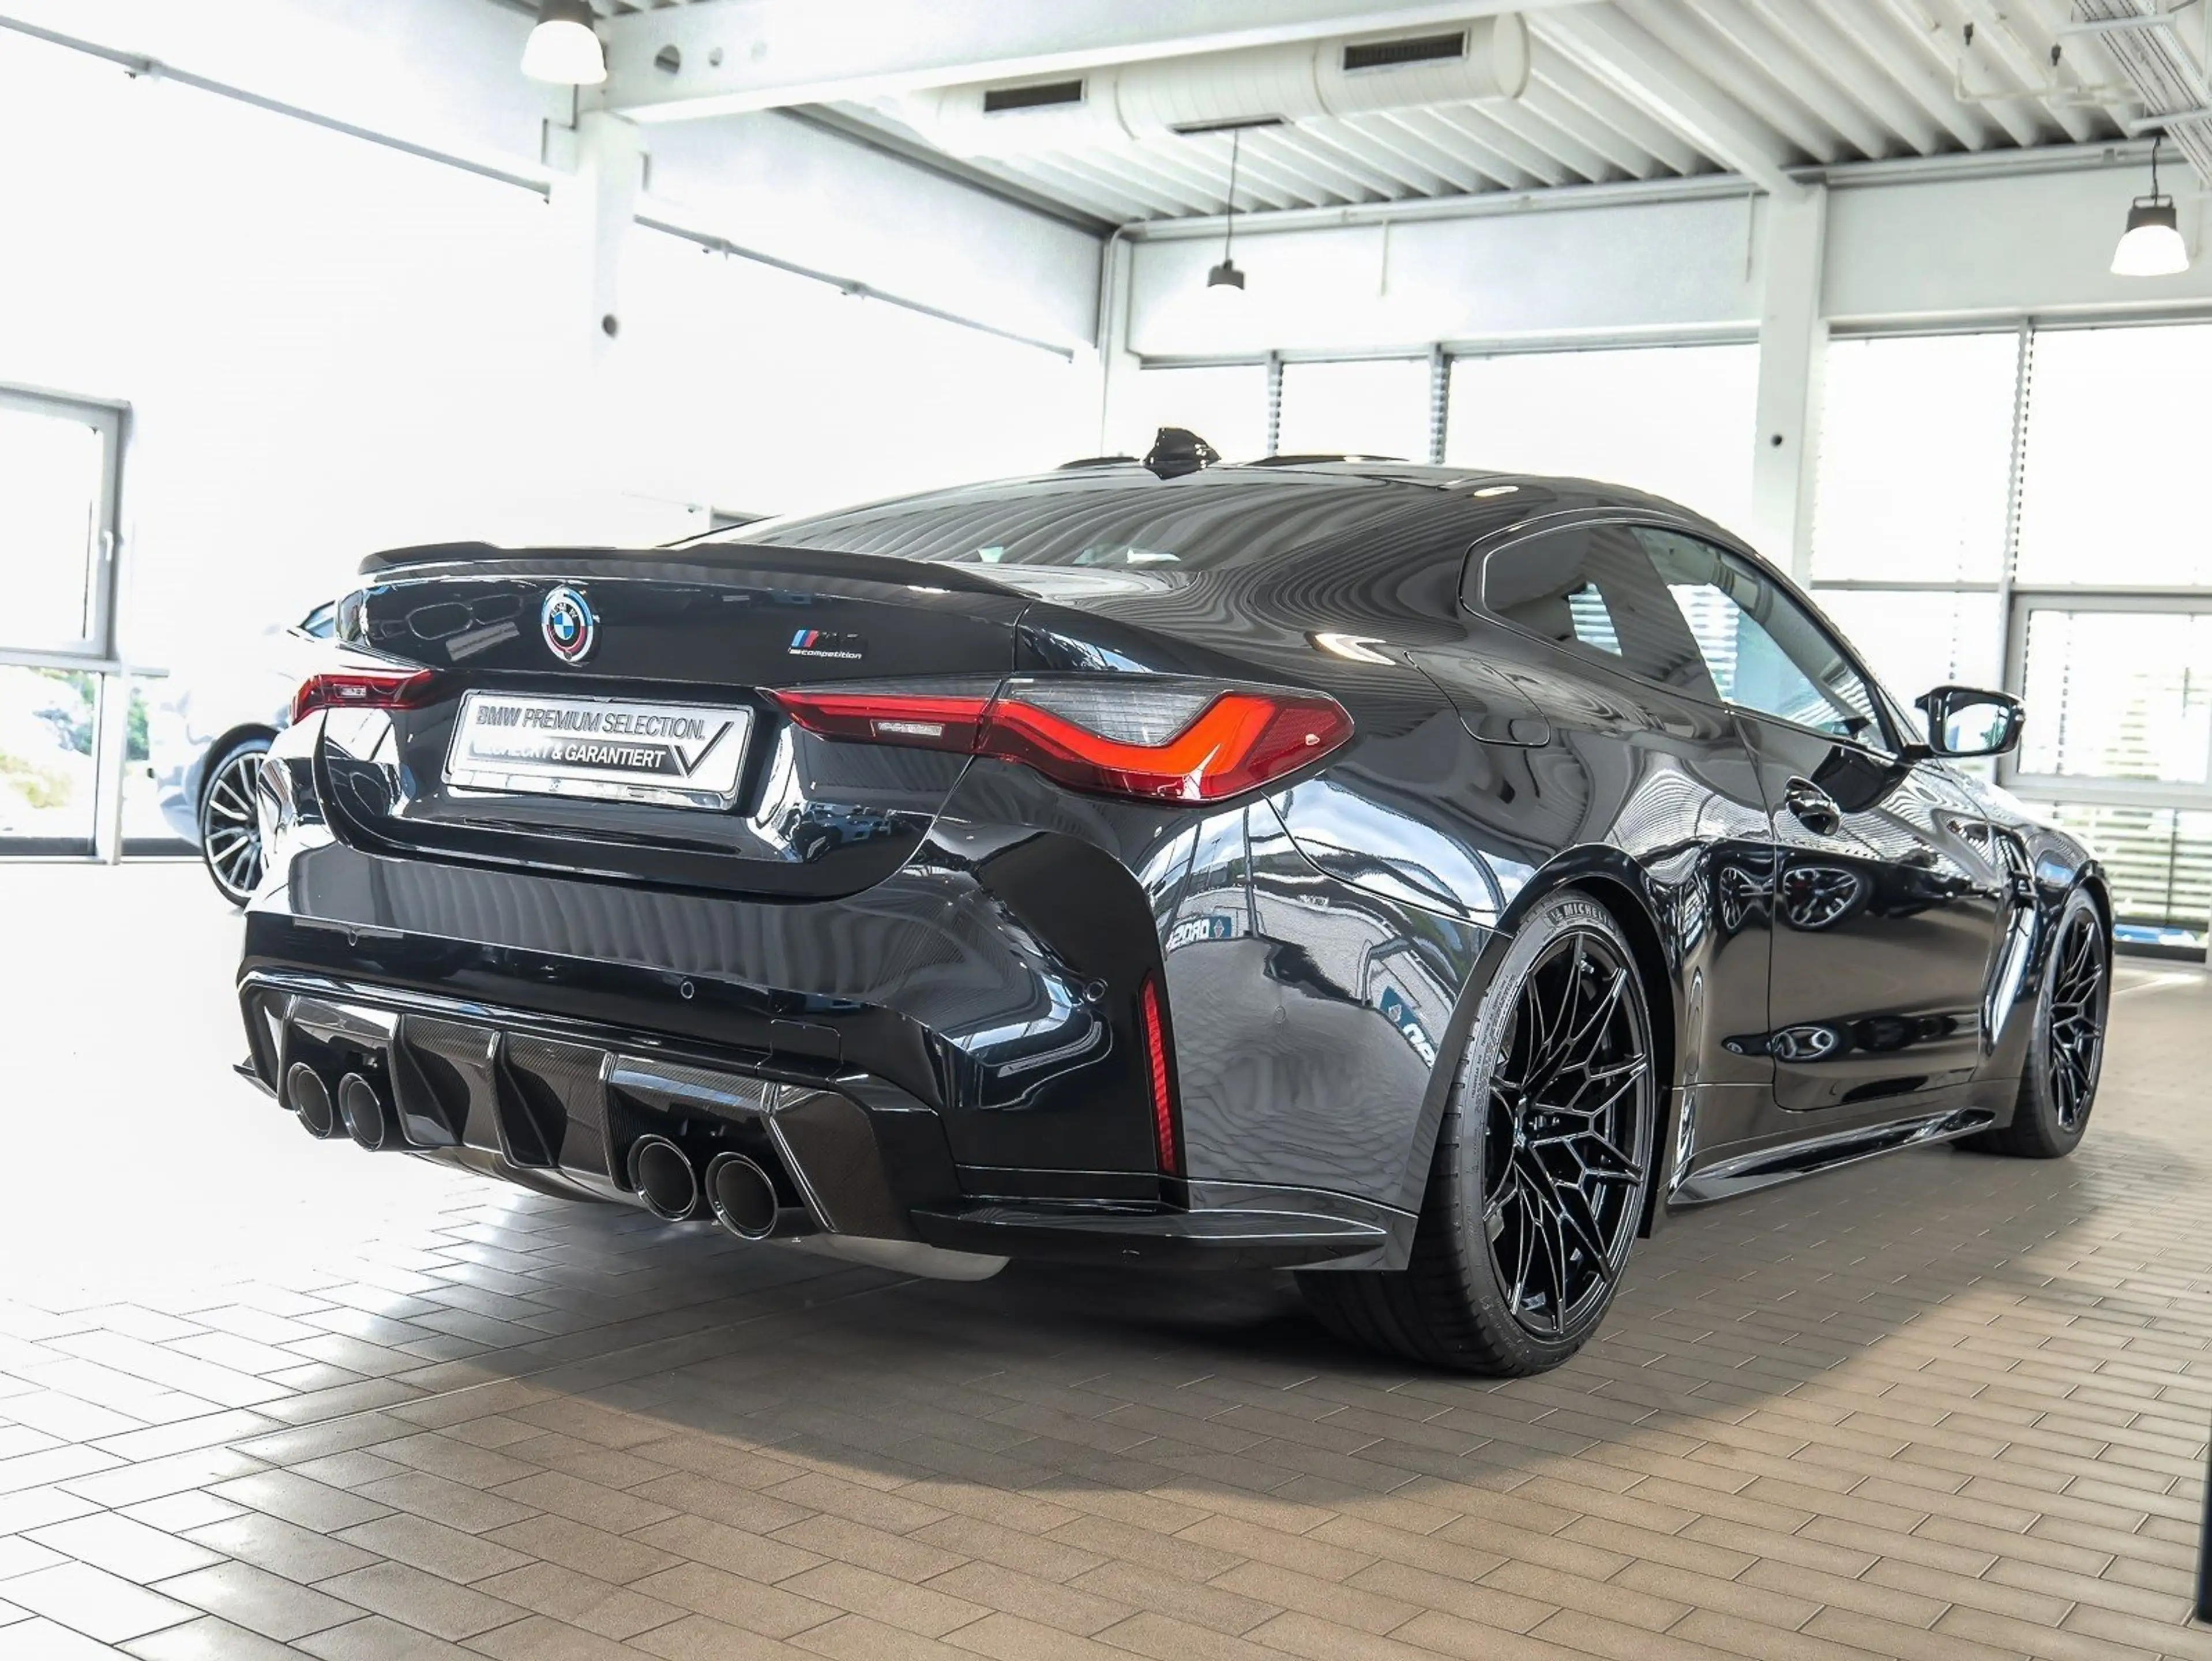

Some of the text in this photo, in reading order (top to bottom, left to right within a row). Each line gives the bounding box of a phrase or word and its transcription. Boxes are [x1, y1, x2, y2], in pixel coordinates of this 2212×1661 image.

[476, 705, 523, 726] BMW
[521, 708, 603, 732] PREMIUM
[551, 741, 563, 760] &
[565, 743, 667, 768] GARANTIERT
